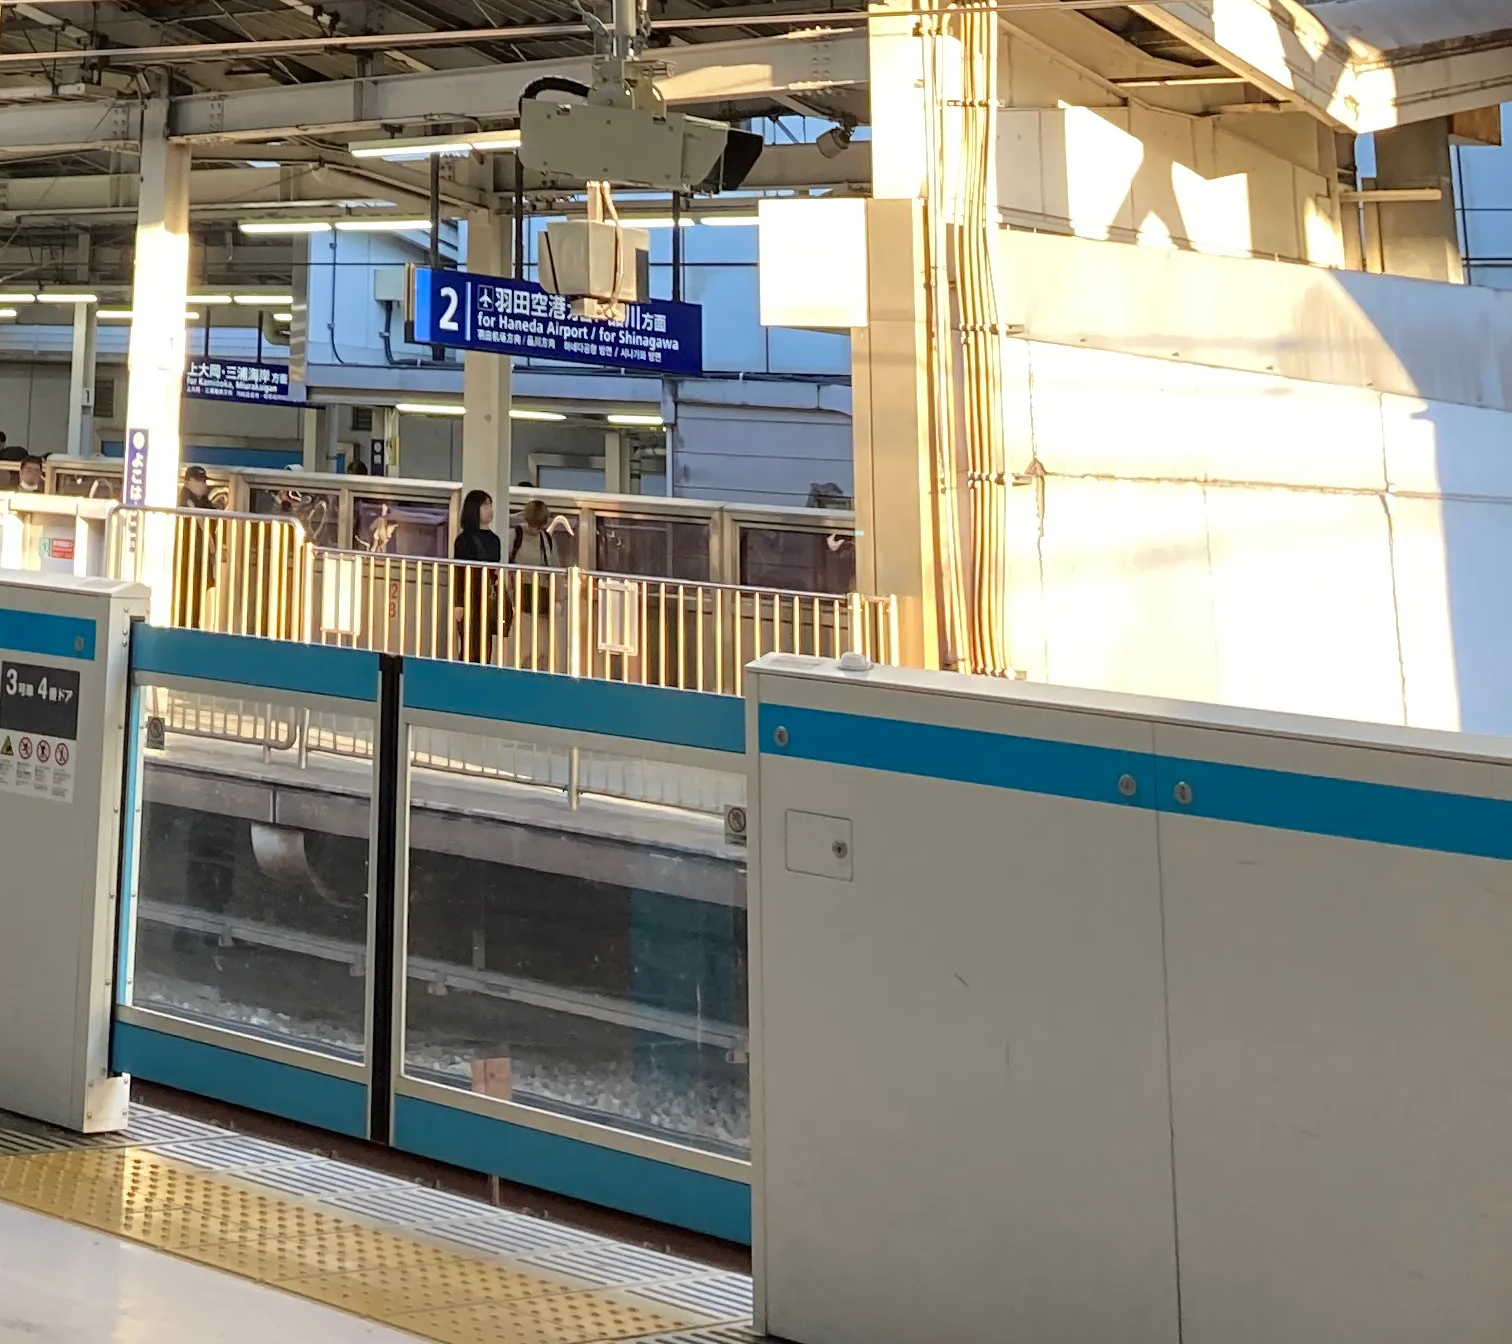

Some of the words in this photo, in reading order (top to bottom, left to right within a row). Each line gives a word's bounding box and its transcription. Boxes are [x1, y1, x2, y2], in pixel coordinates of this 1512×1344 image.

[439, 287, 459, 331] 2
[478, 311, 496, 328] for
[499, 314, 544, 334] Haneda
[546, 321, 588, 340] Airport
[599, 326, 617, 343] for
[618, 330, 679, 351] Shinagawa
